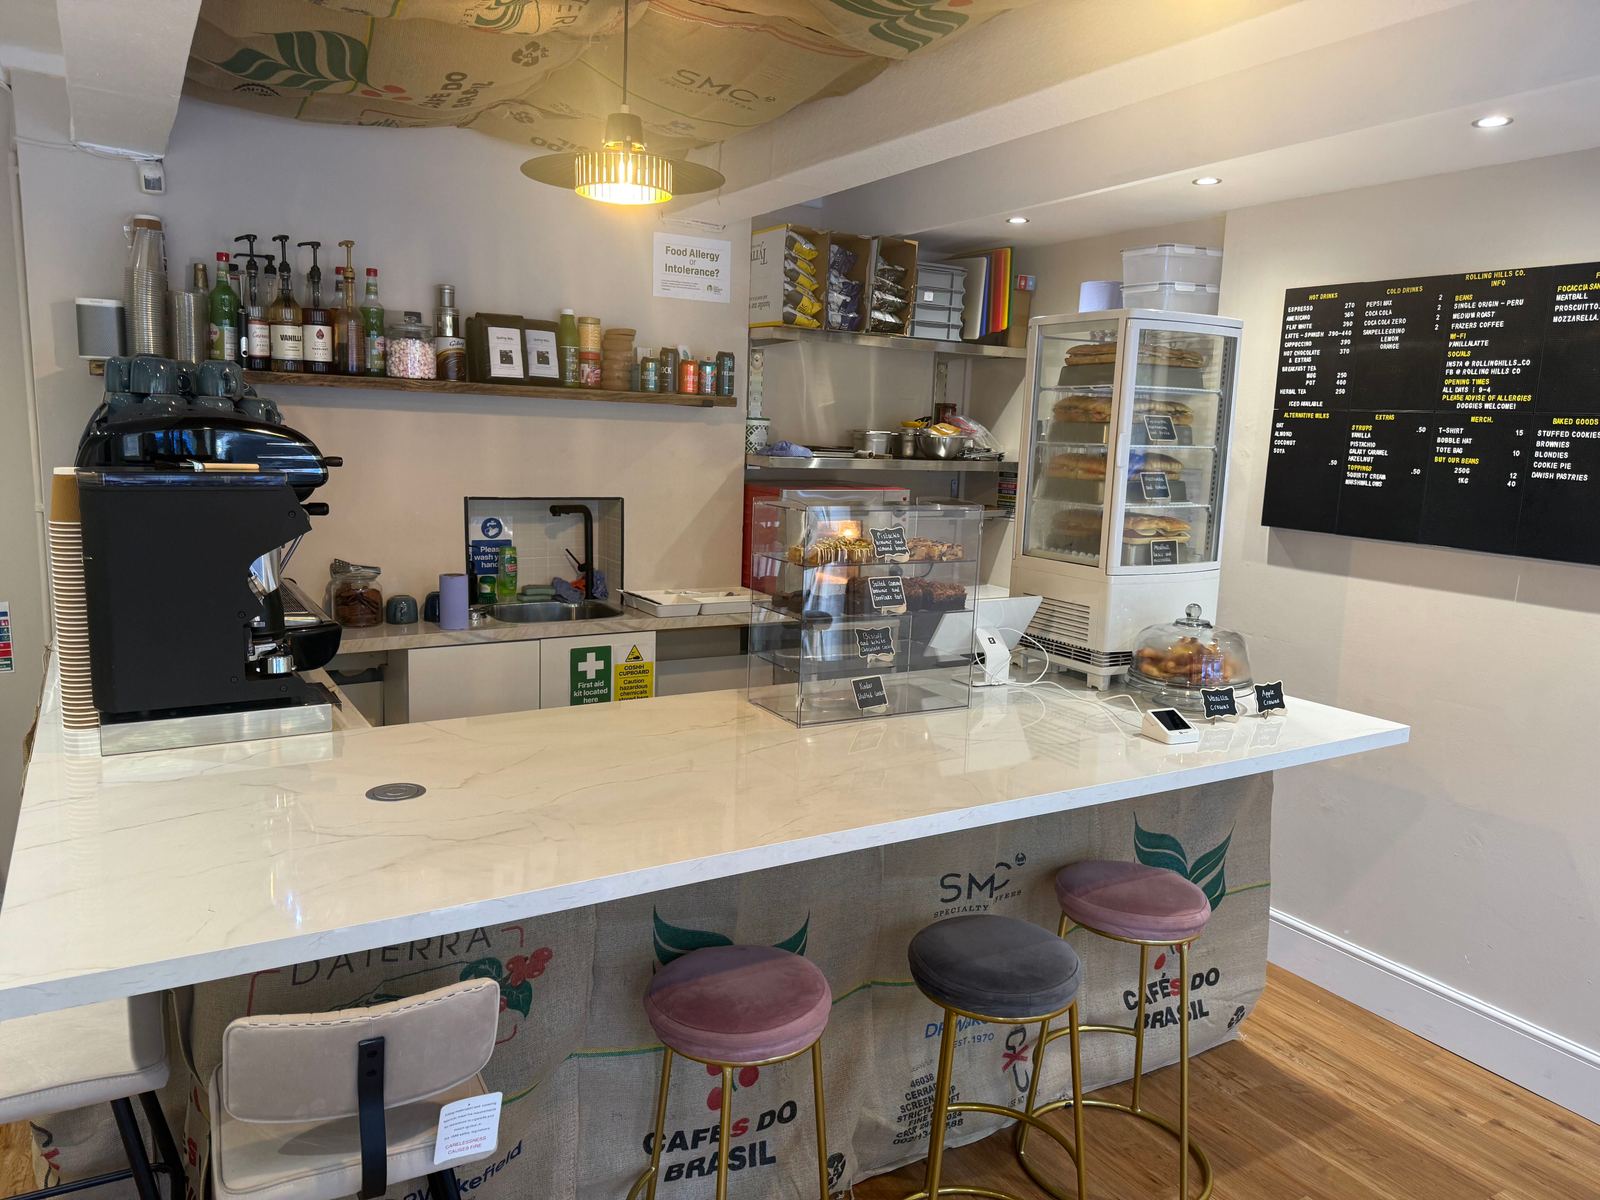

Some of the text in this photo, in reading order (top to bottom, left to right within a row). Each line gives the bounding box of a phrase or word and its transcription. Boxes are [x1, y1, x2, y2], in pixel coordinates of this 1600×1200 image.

[671, 69, 759, 103] SMC
[665, 245, 720, 263] Food Allergy
[664, 263, 720, 278] Intolerance?
[1493, 271, 1513, 279] HILLS
[1402, 286, 1423, 294] DRINKS
[1557, 284, 1588, 292] FOCACCIA
[1556, 293, 1588, 301] MEATBALL
[1534, 451, 1569, 459] BLONDIES
[1533, 461, 1558, 469] COOKIE
[1556, 473, 1588, 481] PASTRIES
[583, 688, 608, 696] located
[1262, 689, 1275, 699] Apple
[940, 862, 1012, 903] SMC
[934, 904, 989, 918] SPECIALTY
[1190, 967, 1221, 992] DO
[1135, 999, 1210, 1031] BRASIL
[910, 1073, 934, 1089] 46038
[901, 1094, 935, 1114] SCREEN
[756, 1100, 798, 1132] DO
[908, 1115, 928, 1127] FINE
[896, 1125, 918, 1139] CROP
[664, 1140, 776, 1182] BRASIL
